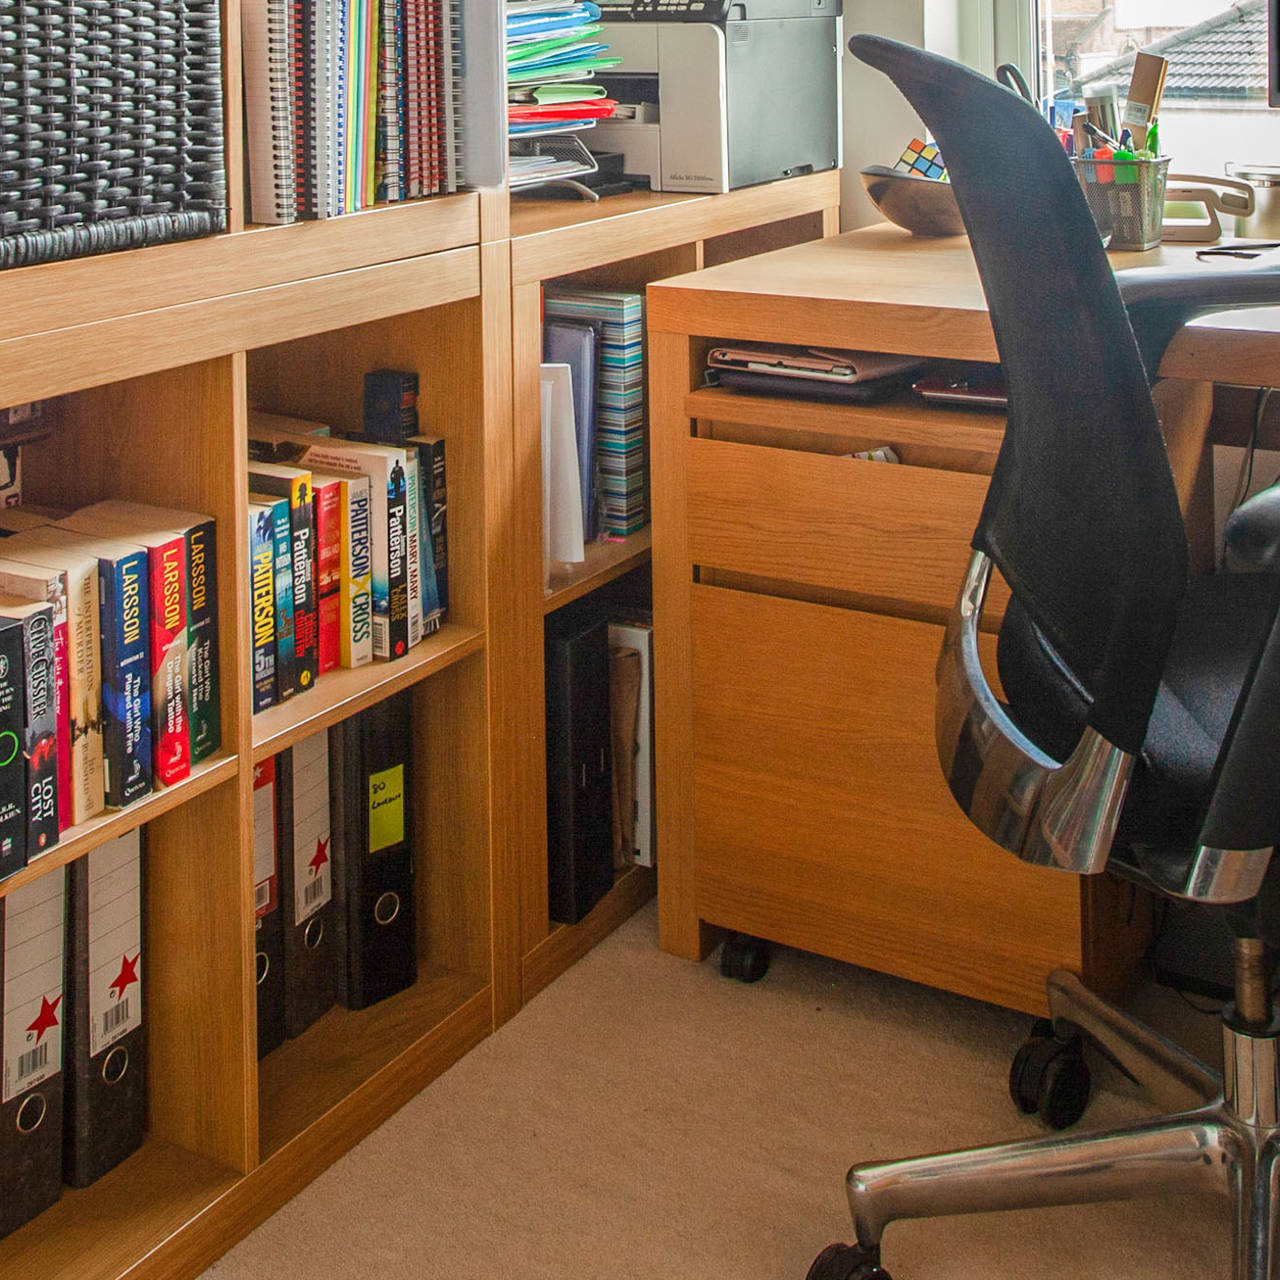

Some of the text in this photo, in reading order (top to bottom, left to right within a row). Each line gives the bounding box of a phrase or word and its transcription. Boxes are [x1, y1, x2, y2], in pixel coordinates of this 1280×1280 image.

[191, 532, 205, 611] LARSSON
[293, 527, 310, 605] Patterson
[350, 497, 370, 644] PATTERSON CROSS
[389, 504, 404, 578] Patterson
[122, 561, 140, 645] LARSSON
[163, 549, 180, 631] LARSSON
[253, 550, 275, 648] PATTERSON
[30, 615, 48, 721] CLIVE CUSSLER
[31, 783, 43, 822] CITY
[40, 776, 54, 818] LOST
[371, 781, 386, 795] 80
